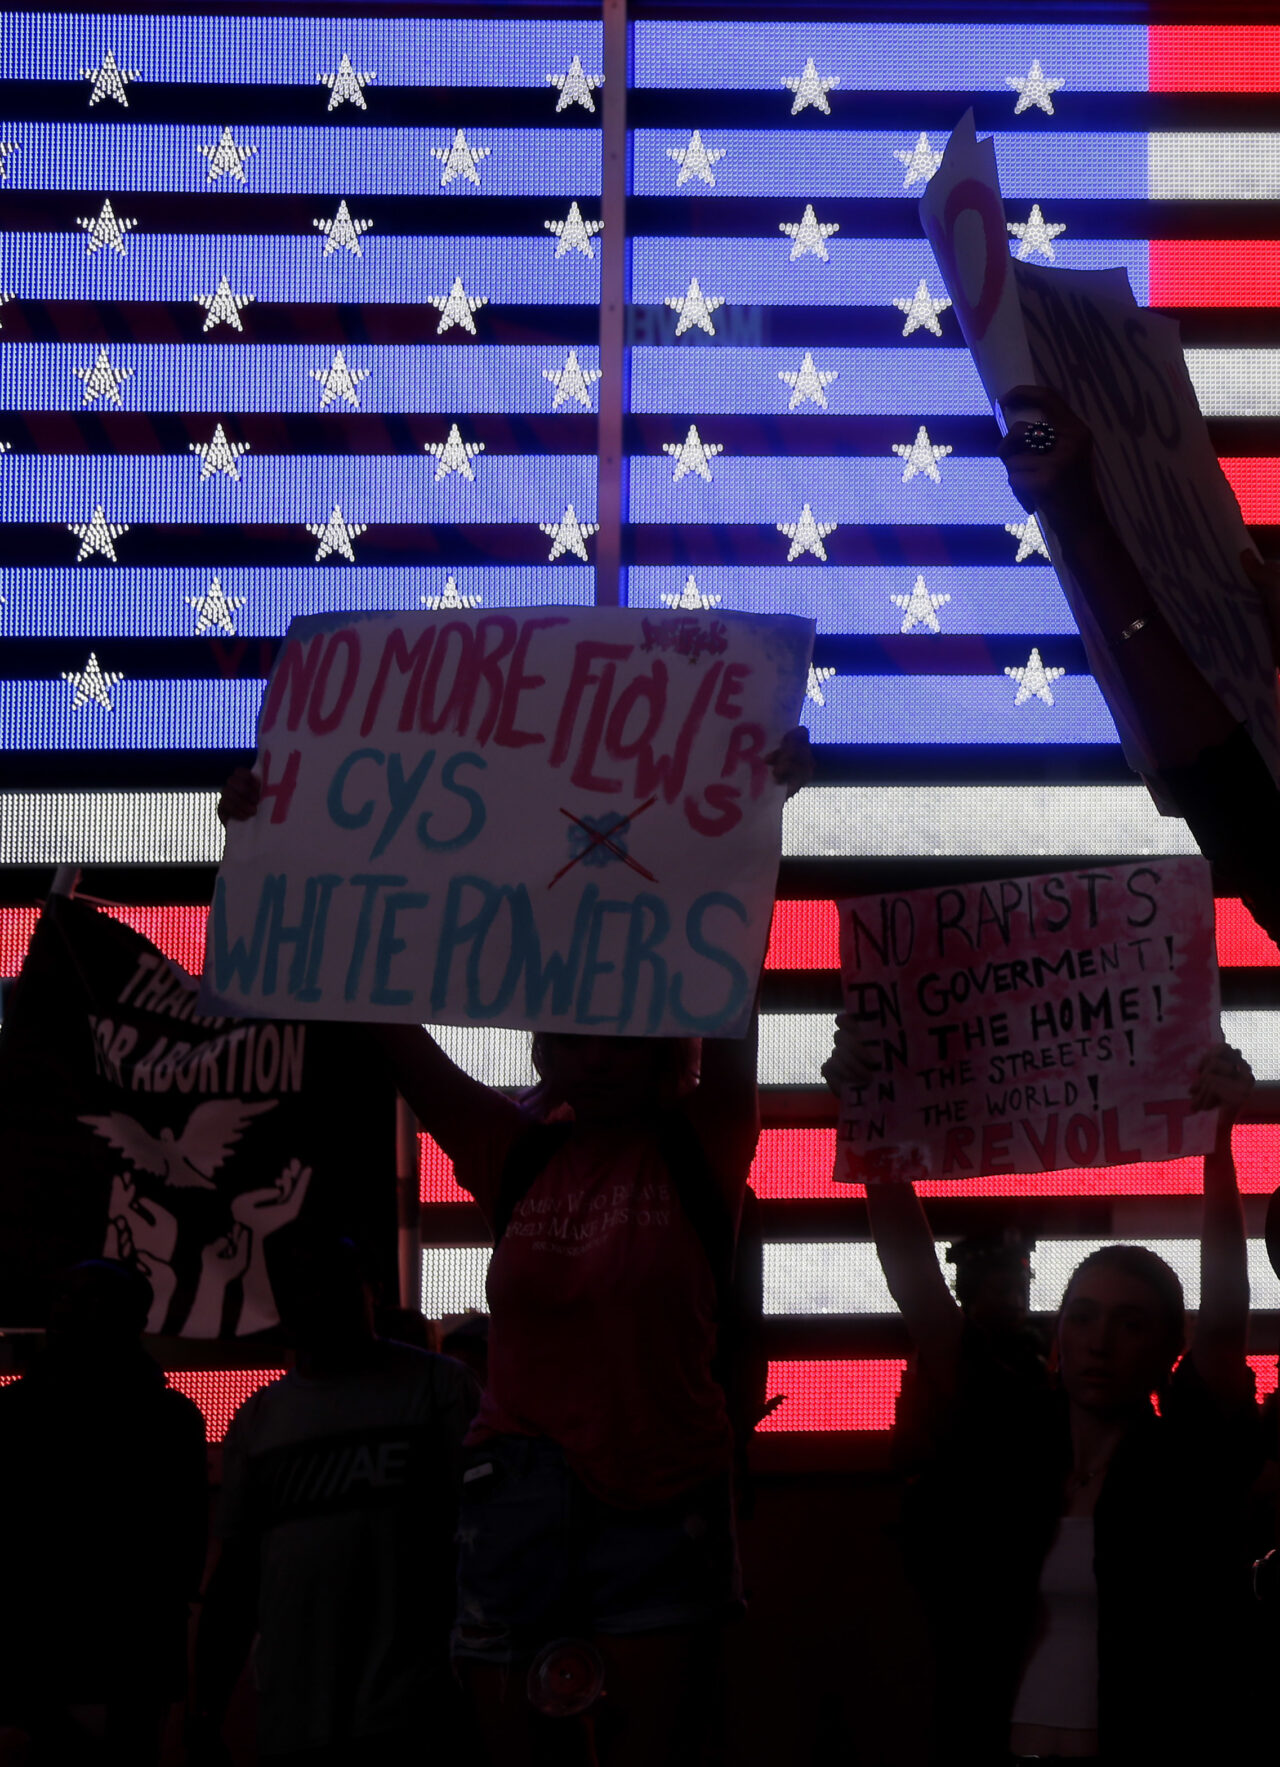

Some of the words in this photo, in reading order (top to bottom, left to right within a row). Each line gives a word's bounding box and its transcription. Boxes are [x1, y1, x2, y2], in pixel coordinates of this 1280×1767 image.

[260, 627, 362, 738] NO
[360, 615, 570, 747] MORE
[326, 747, 488, 862] CYS
[212, 873, 428, 1006] WHITE
[430, 874, 751, 1036] POWERS
[851, 896, 915, 969] NO
[936, 868, 1161, 958] RAPISTS
[848, 982, 903, 1028] IN
[917, 935, 1176, 1017] GOVERMENT!
[928, 1012, 1010, 1061] THE
[1031, 985, 1165, 1042] HOME!
[131, 1021, 307, 1095] ABORTION
[849, 1080, 896, 1108] IN
[917, 1060, 977, 1092] THE
[988, 1030, 1137, 1085] STREETS!
[840, 1113, 887, 1142] IN
[918, 1100, 969, 1129] THE
[985, 1074, 1101, 1118] WORLD!
[941, 1098, 1198, 1174] REVOLT
